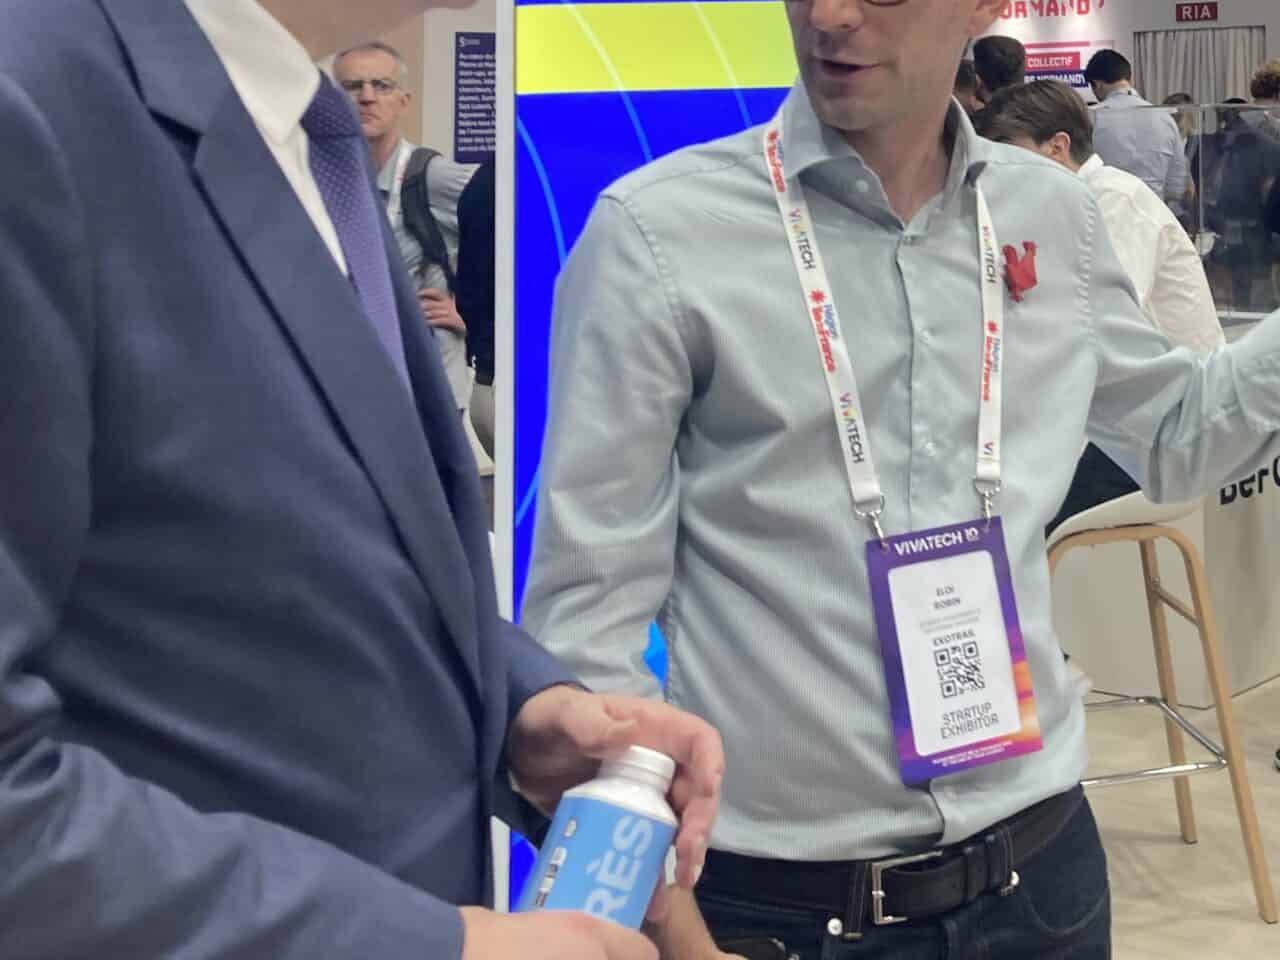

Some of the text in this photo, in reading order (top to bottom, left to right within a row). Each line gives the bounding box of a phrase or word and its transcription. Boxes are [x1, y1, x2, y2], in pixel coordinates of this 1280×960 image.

[1182, 4, 1212, 20] RIA
[894, 530, 963, 556] VIVATECH
[940, 713, 1000, 739] EXHIBITOR
[942, 702, 993, 727] STARTUP
